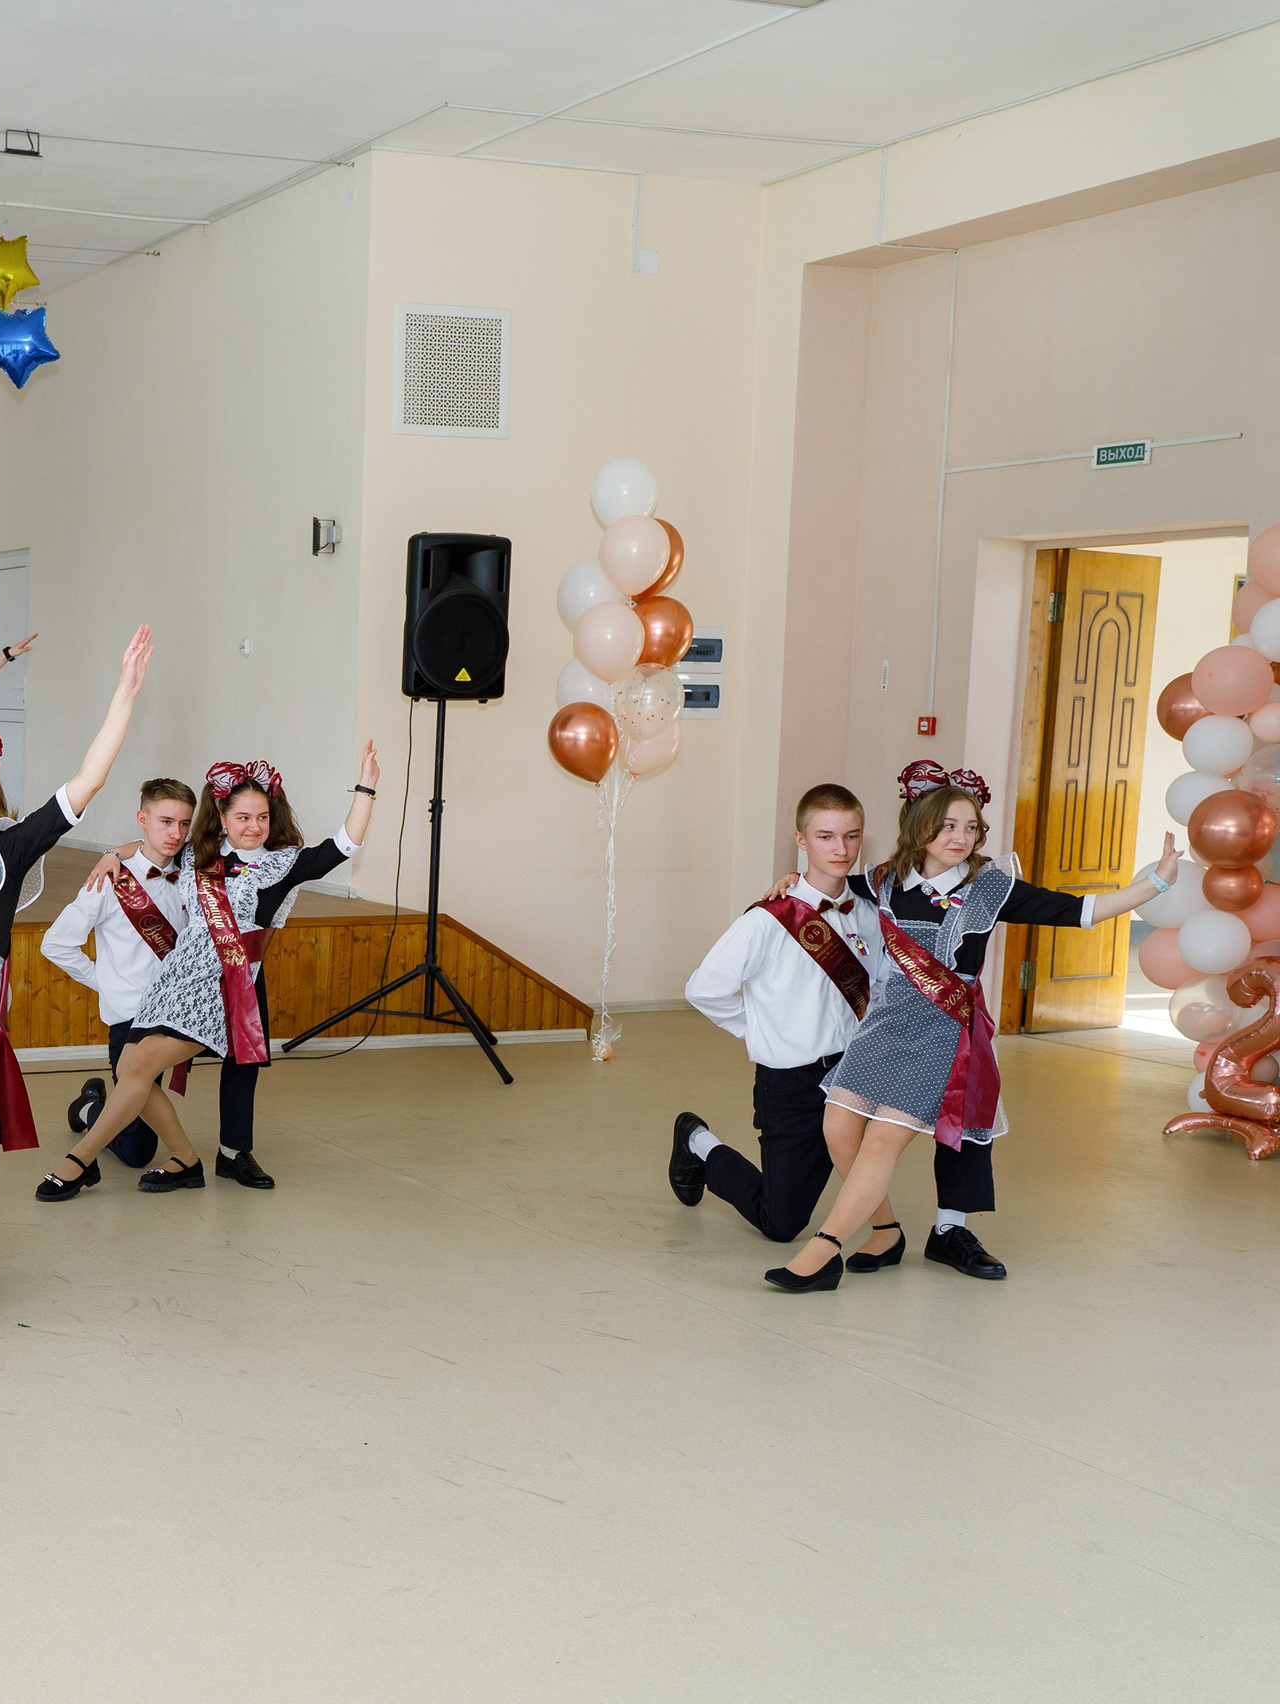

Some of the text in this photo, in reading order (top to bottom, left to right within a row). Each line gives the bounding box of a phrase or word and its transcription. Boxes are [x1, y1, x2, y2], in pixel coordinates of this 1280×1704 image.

[1099, 445, 1144, 462] ВЫХОД
[880, 922, 945, 995] Выпускница
[943, 983, 967, 1011] 2023
